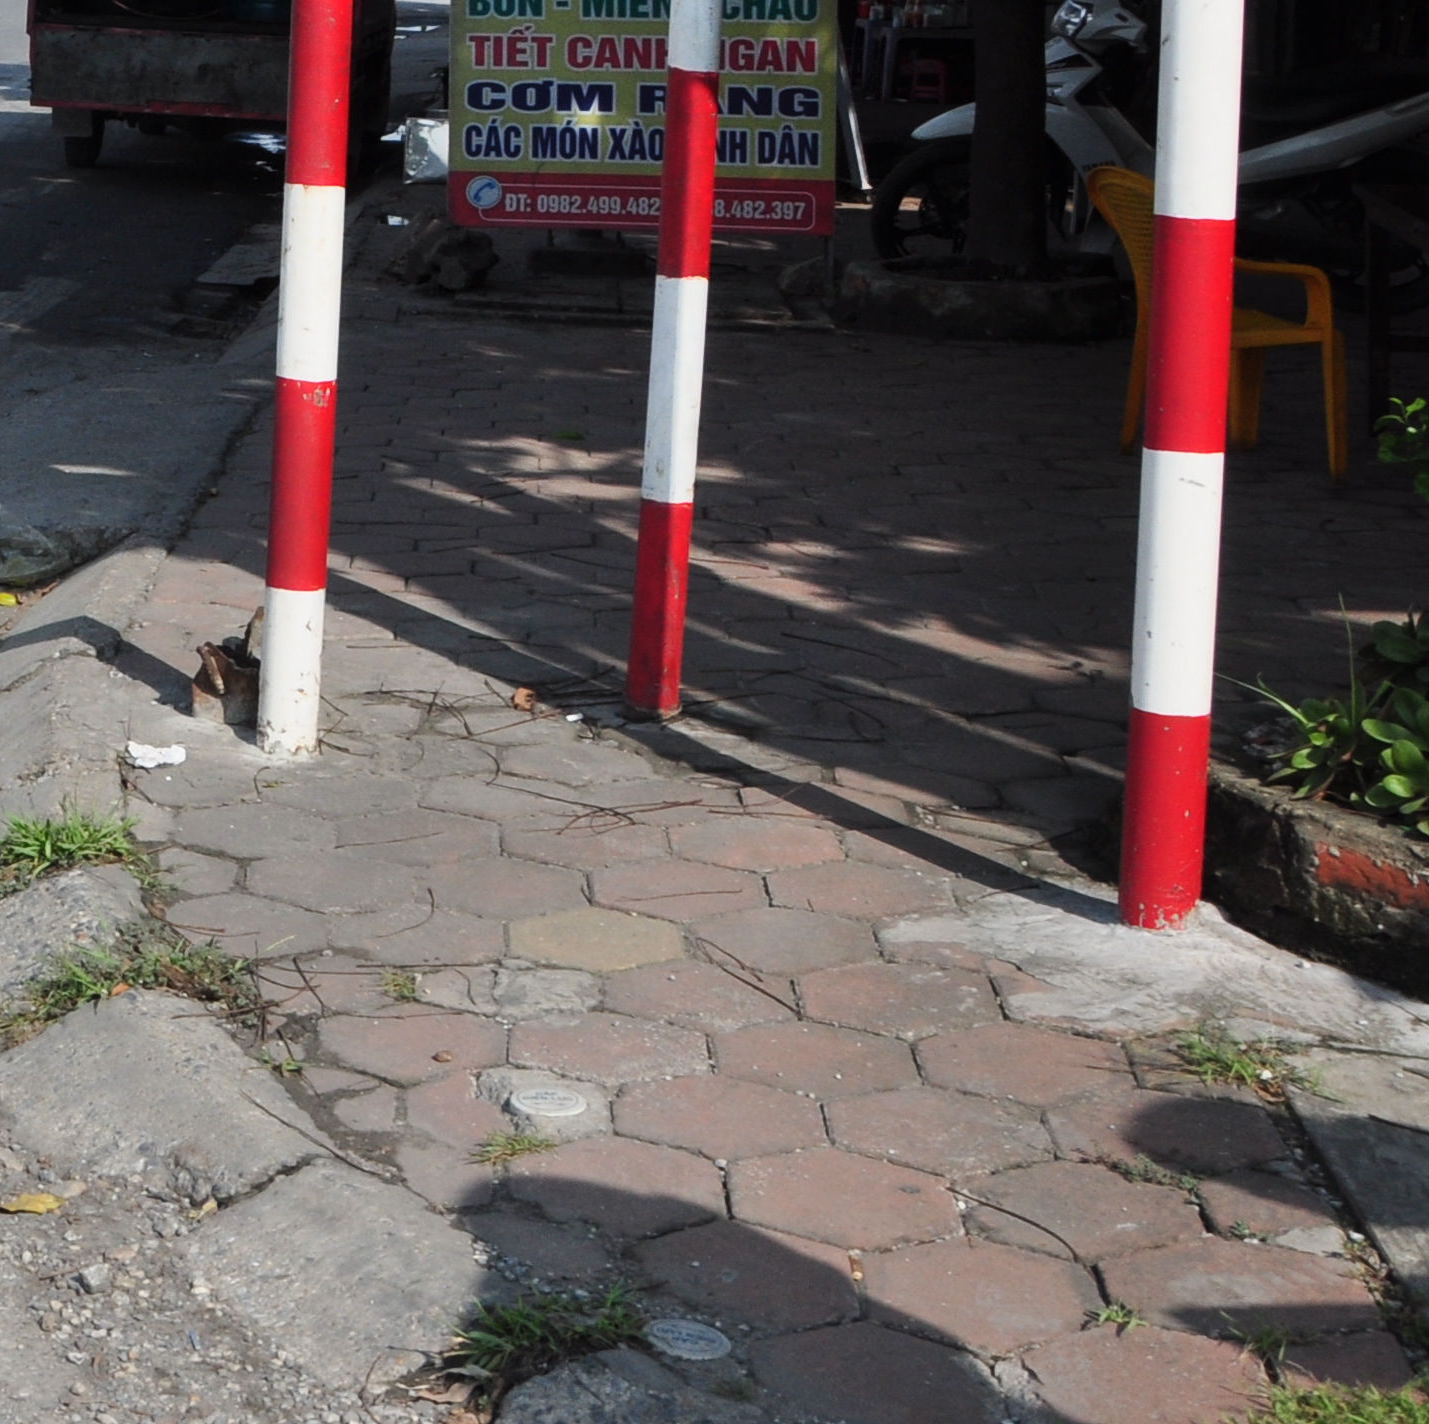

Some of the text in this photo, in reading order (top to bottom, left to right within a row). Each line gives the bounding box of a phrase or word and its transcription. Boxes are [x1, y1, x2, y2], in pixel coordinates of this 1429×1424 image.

[467, 25, 554, 69] TIẾT
[465, 80, 615, 115] CƠM
[464, 118, 522, 160] CÁC
[531, 120, 600, 161] MÓN
[608, 120, 664, 162] XÀO
[757, 124, 821, 168] DÂN
[504, 193, 531, 213] ĐT:
[537, 194, 661, 216] 0982.499.482
